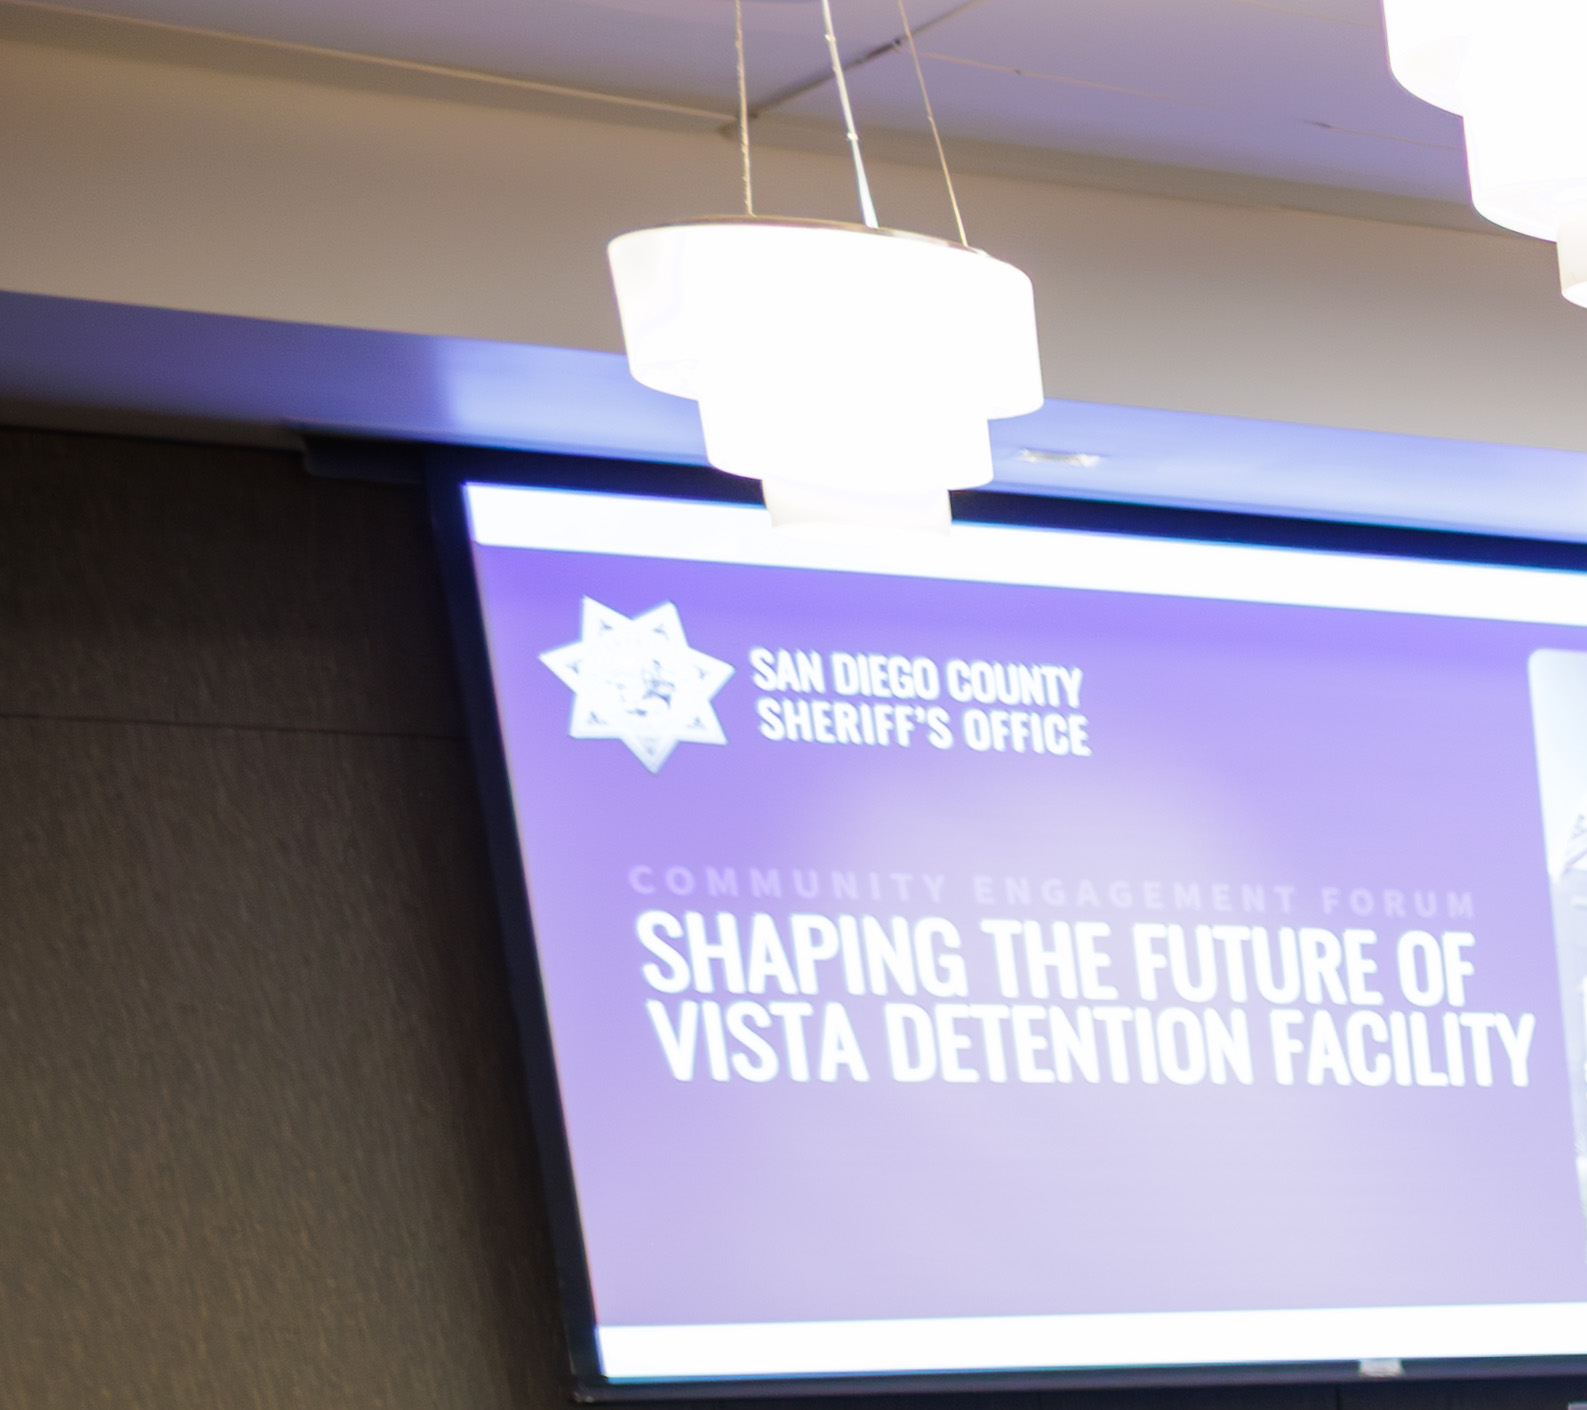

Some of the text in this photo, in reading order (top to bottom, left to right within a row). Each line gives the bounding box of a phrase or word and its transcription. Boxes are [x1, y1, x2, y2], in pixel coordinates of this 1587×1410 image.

[749, 646, 1083, 709] SAN DIEGO COUNTY
[754, 697, 1093, 757] SHERIFF'S OFFICE
[628, 864, 1476, 920] COMMUNITY ENGAGEMENT FORUM
[635, 908, 1476, 1008] SHAPING THE FUTURE OF
[645, 998, 1537, 1088] VISTA DETENTION FACILITY
